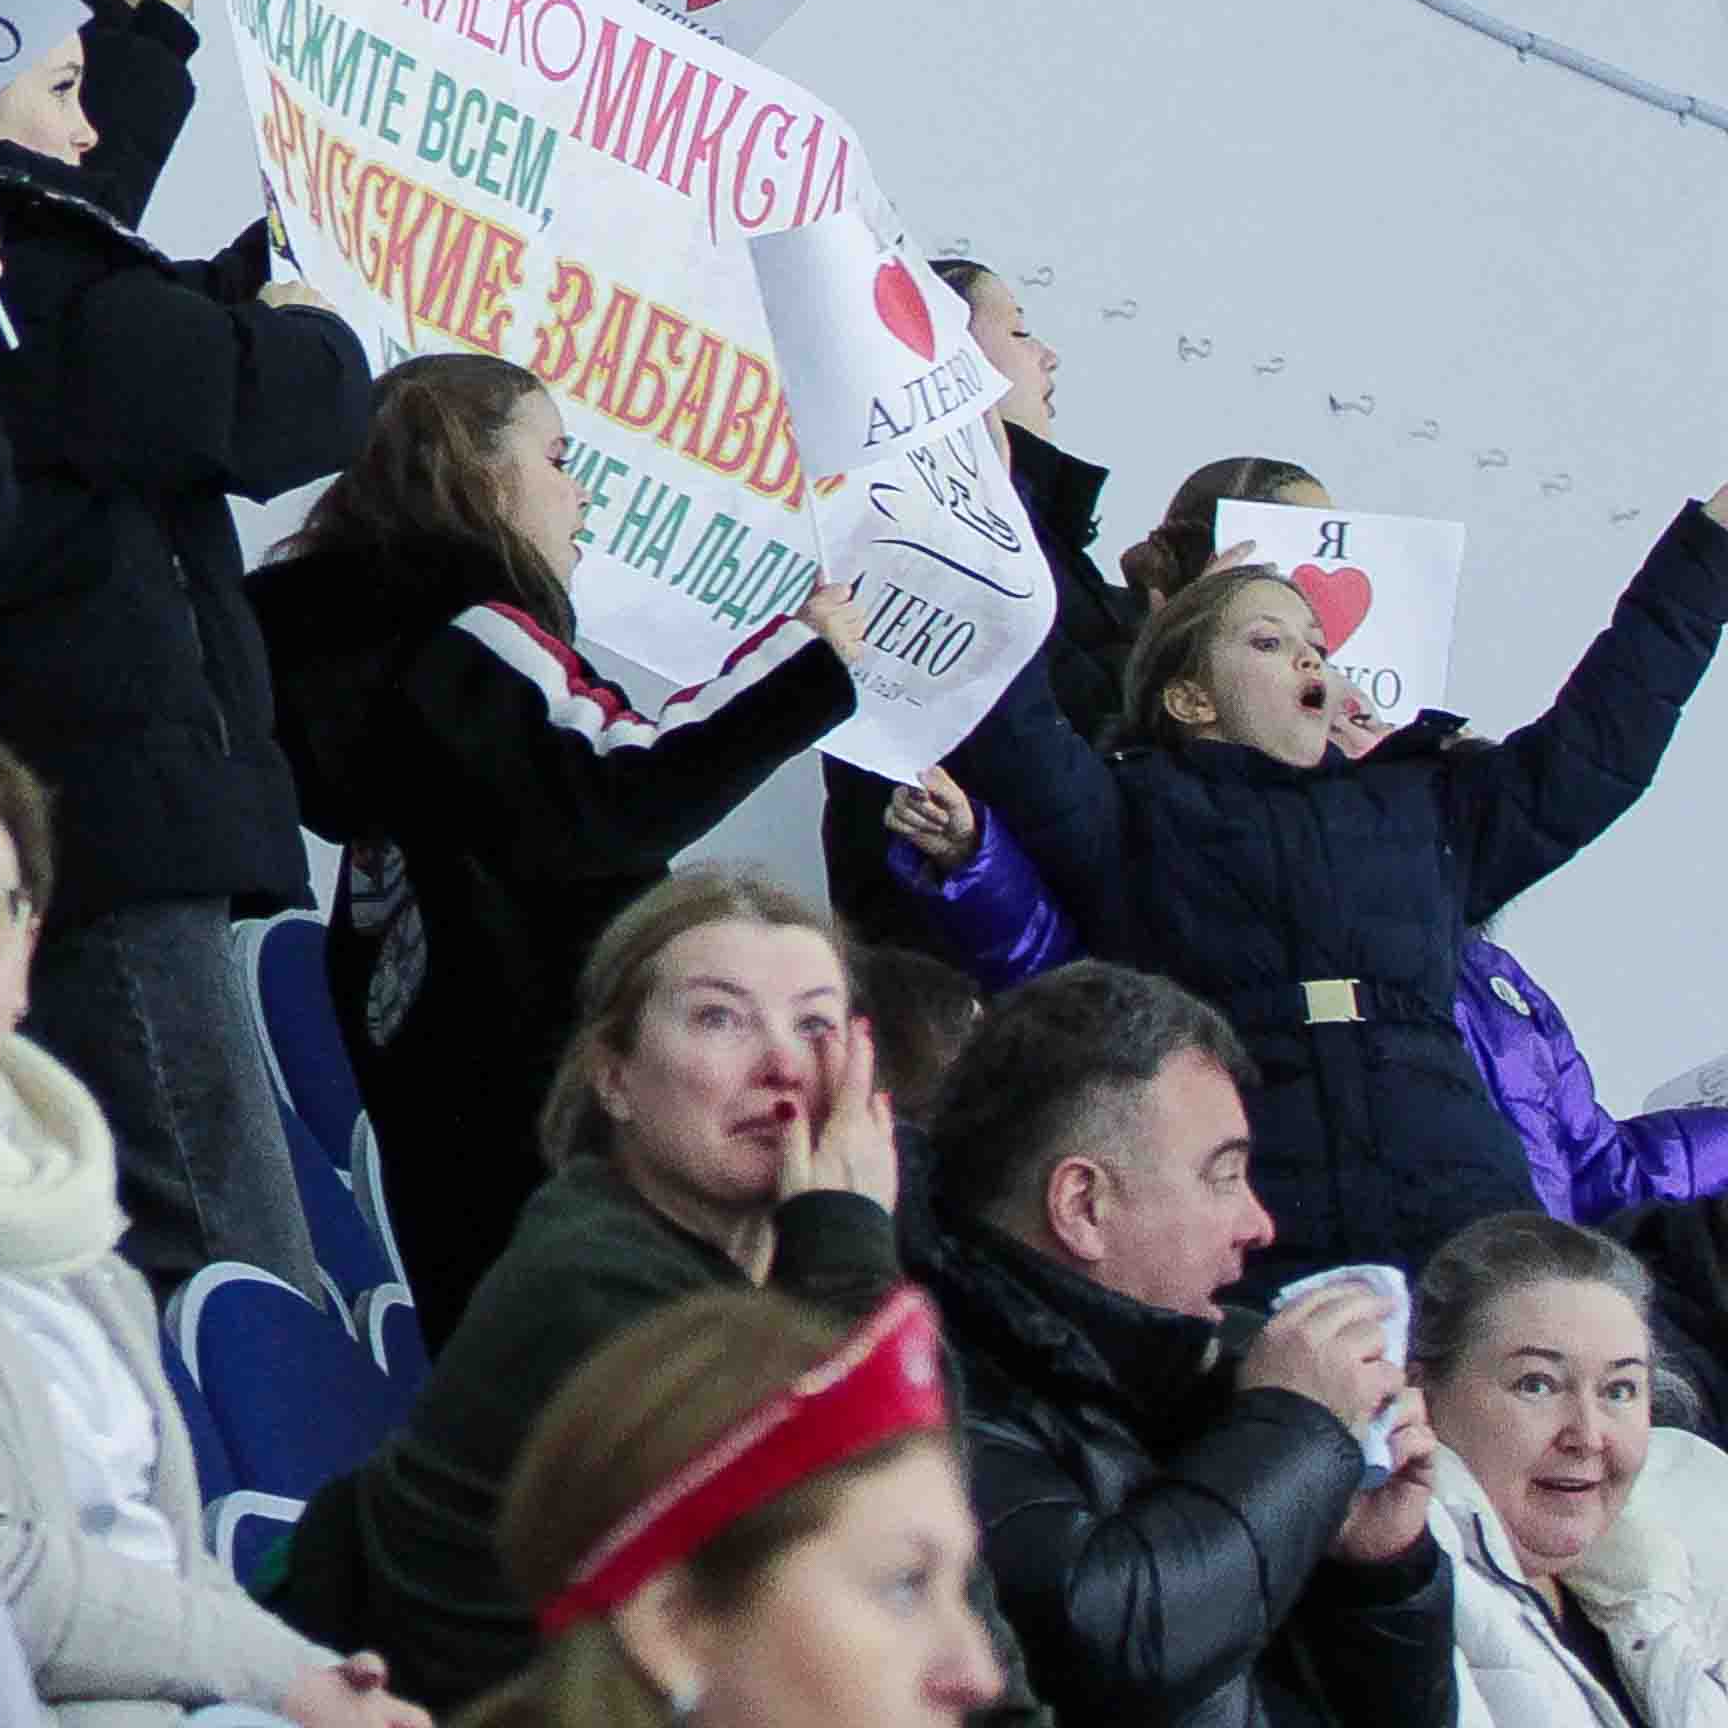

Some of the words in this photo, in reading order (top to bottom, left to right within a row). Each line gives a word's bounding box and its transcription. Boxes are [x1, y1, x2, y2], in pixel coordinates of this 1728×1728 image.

[415, 69, 558, 232] ВСЕМ,
[862, 346, 985, 449] АЛЕКО
[606, 474, 692, 579] НА
[1312, 520, 1352, 561] Я
